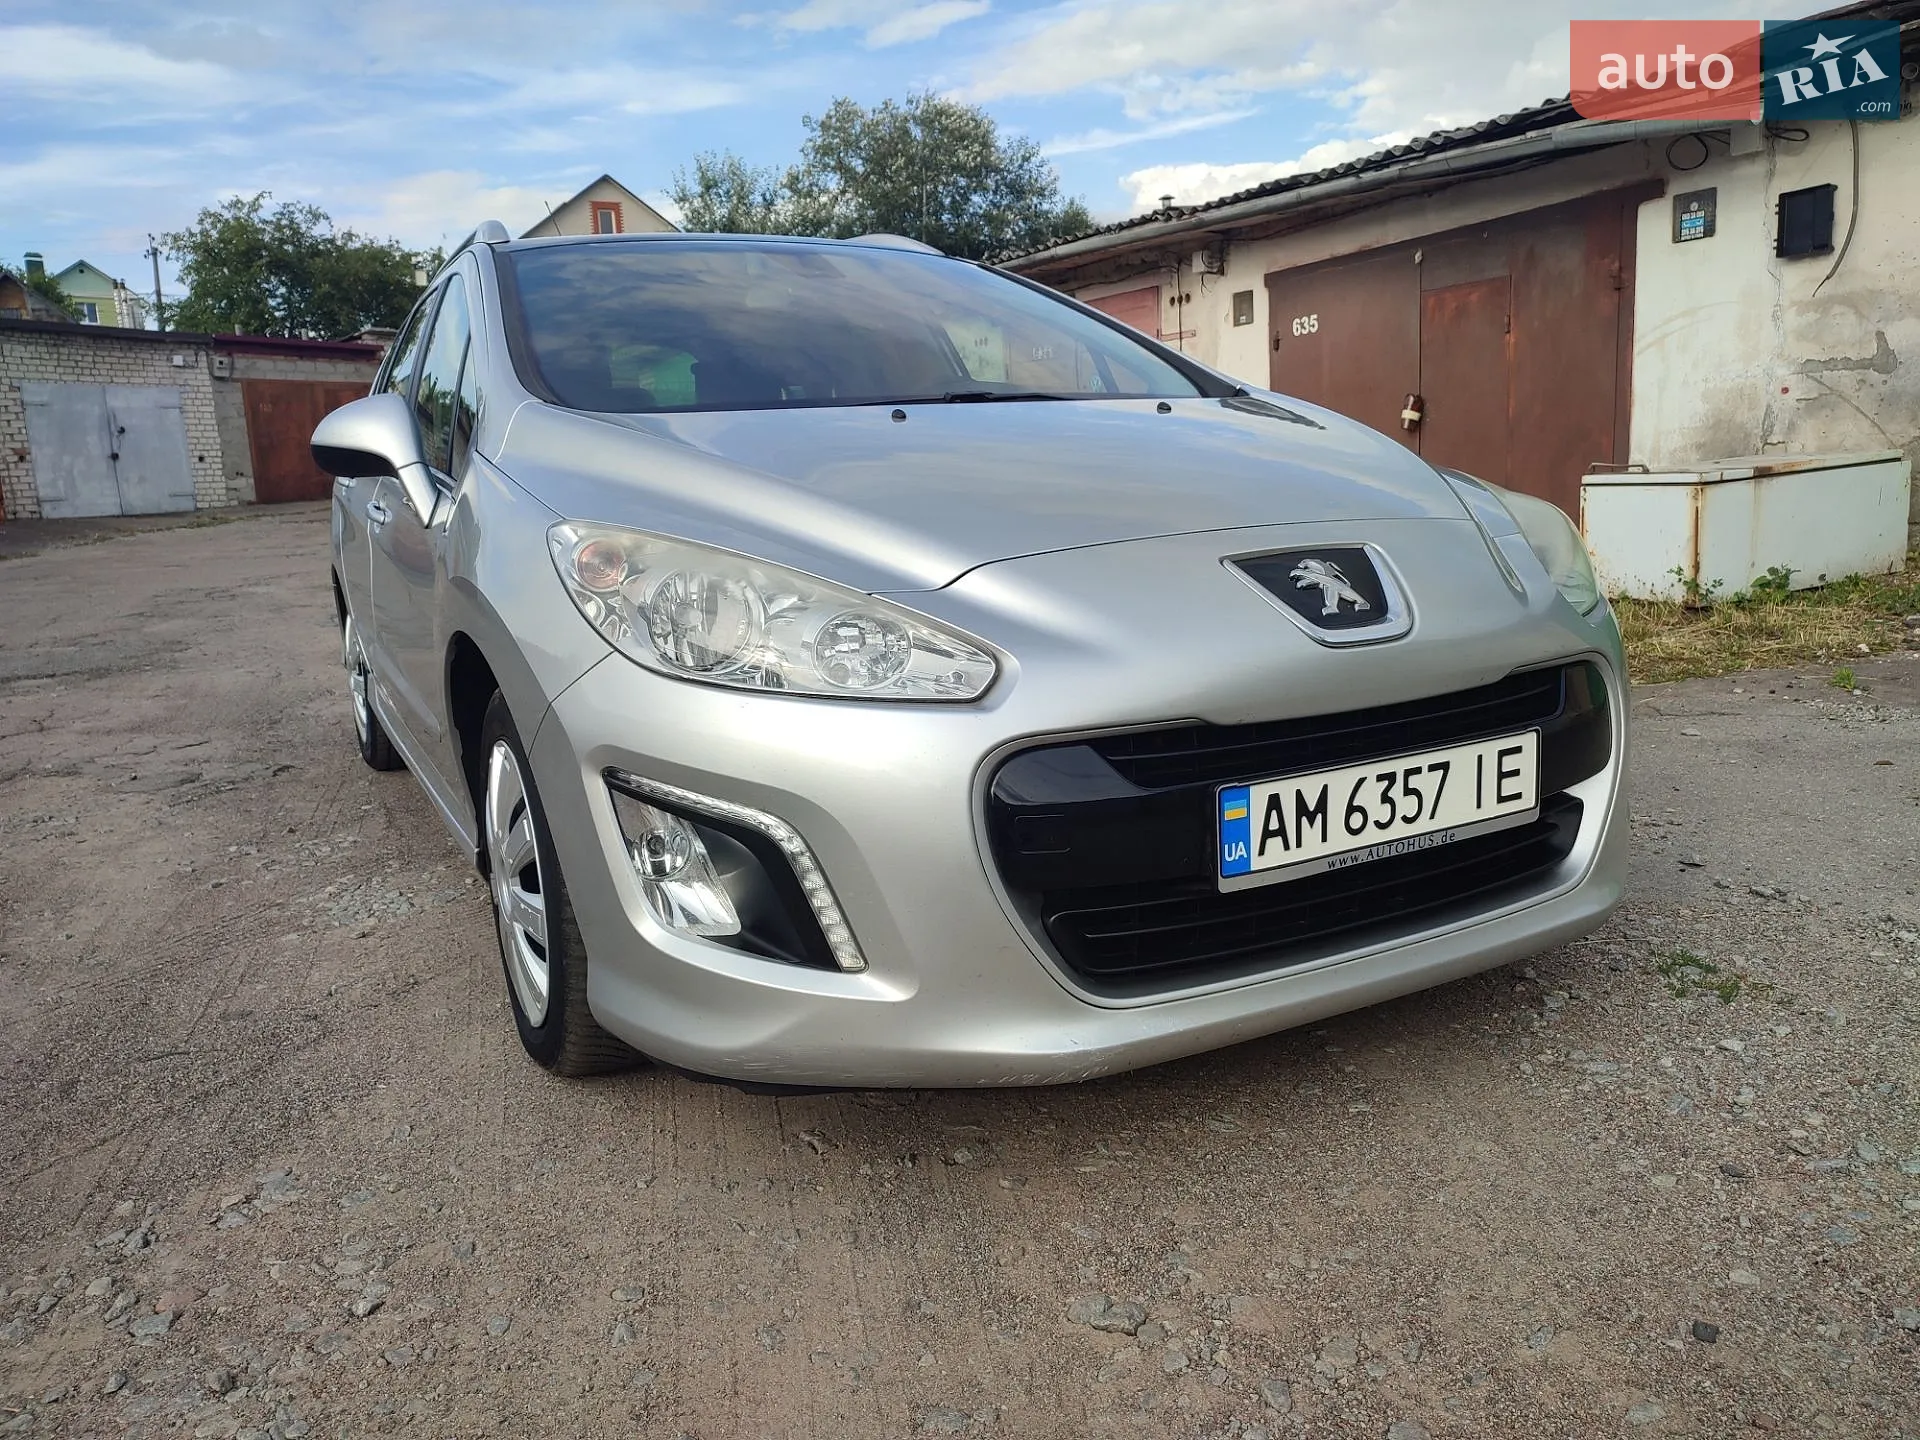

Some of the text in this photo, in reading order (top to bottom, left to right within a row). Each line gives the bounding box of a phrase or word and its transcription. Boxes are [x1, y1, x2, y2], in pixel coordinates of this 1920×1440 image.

[1292, 313, 1319, 337] 635
[1257, 745, 1523, 857] AM 6357 IE
[1224, 841, 1248, 862] UA
[1326, 830, 1456, 870] www.AUTOHUS.de
